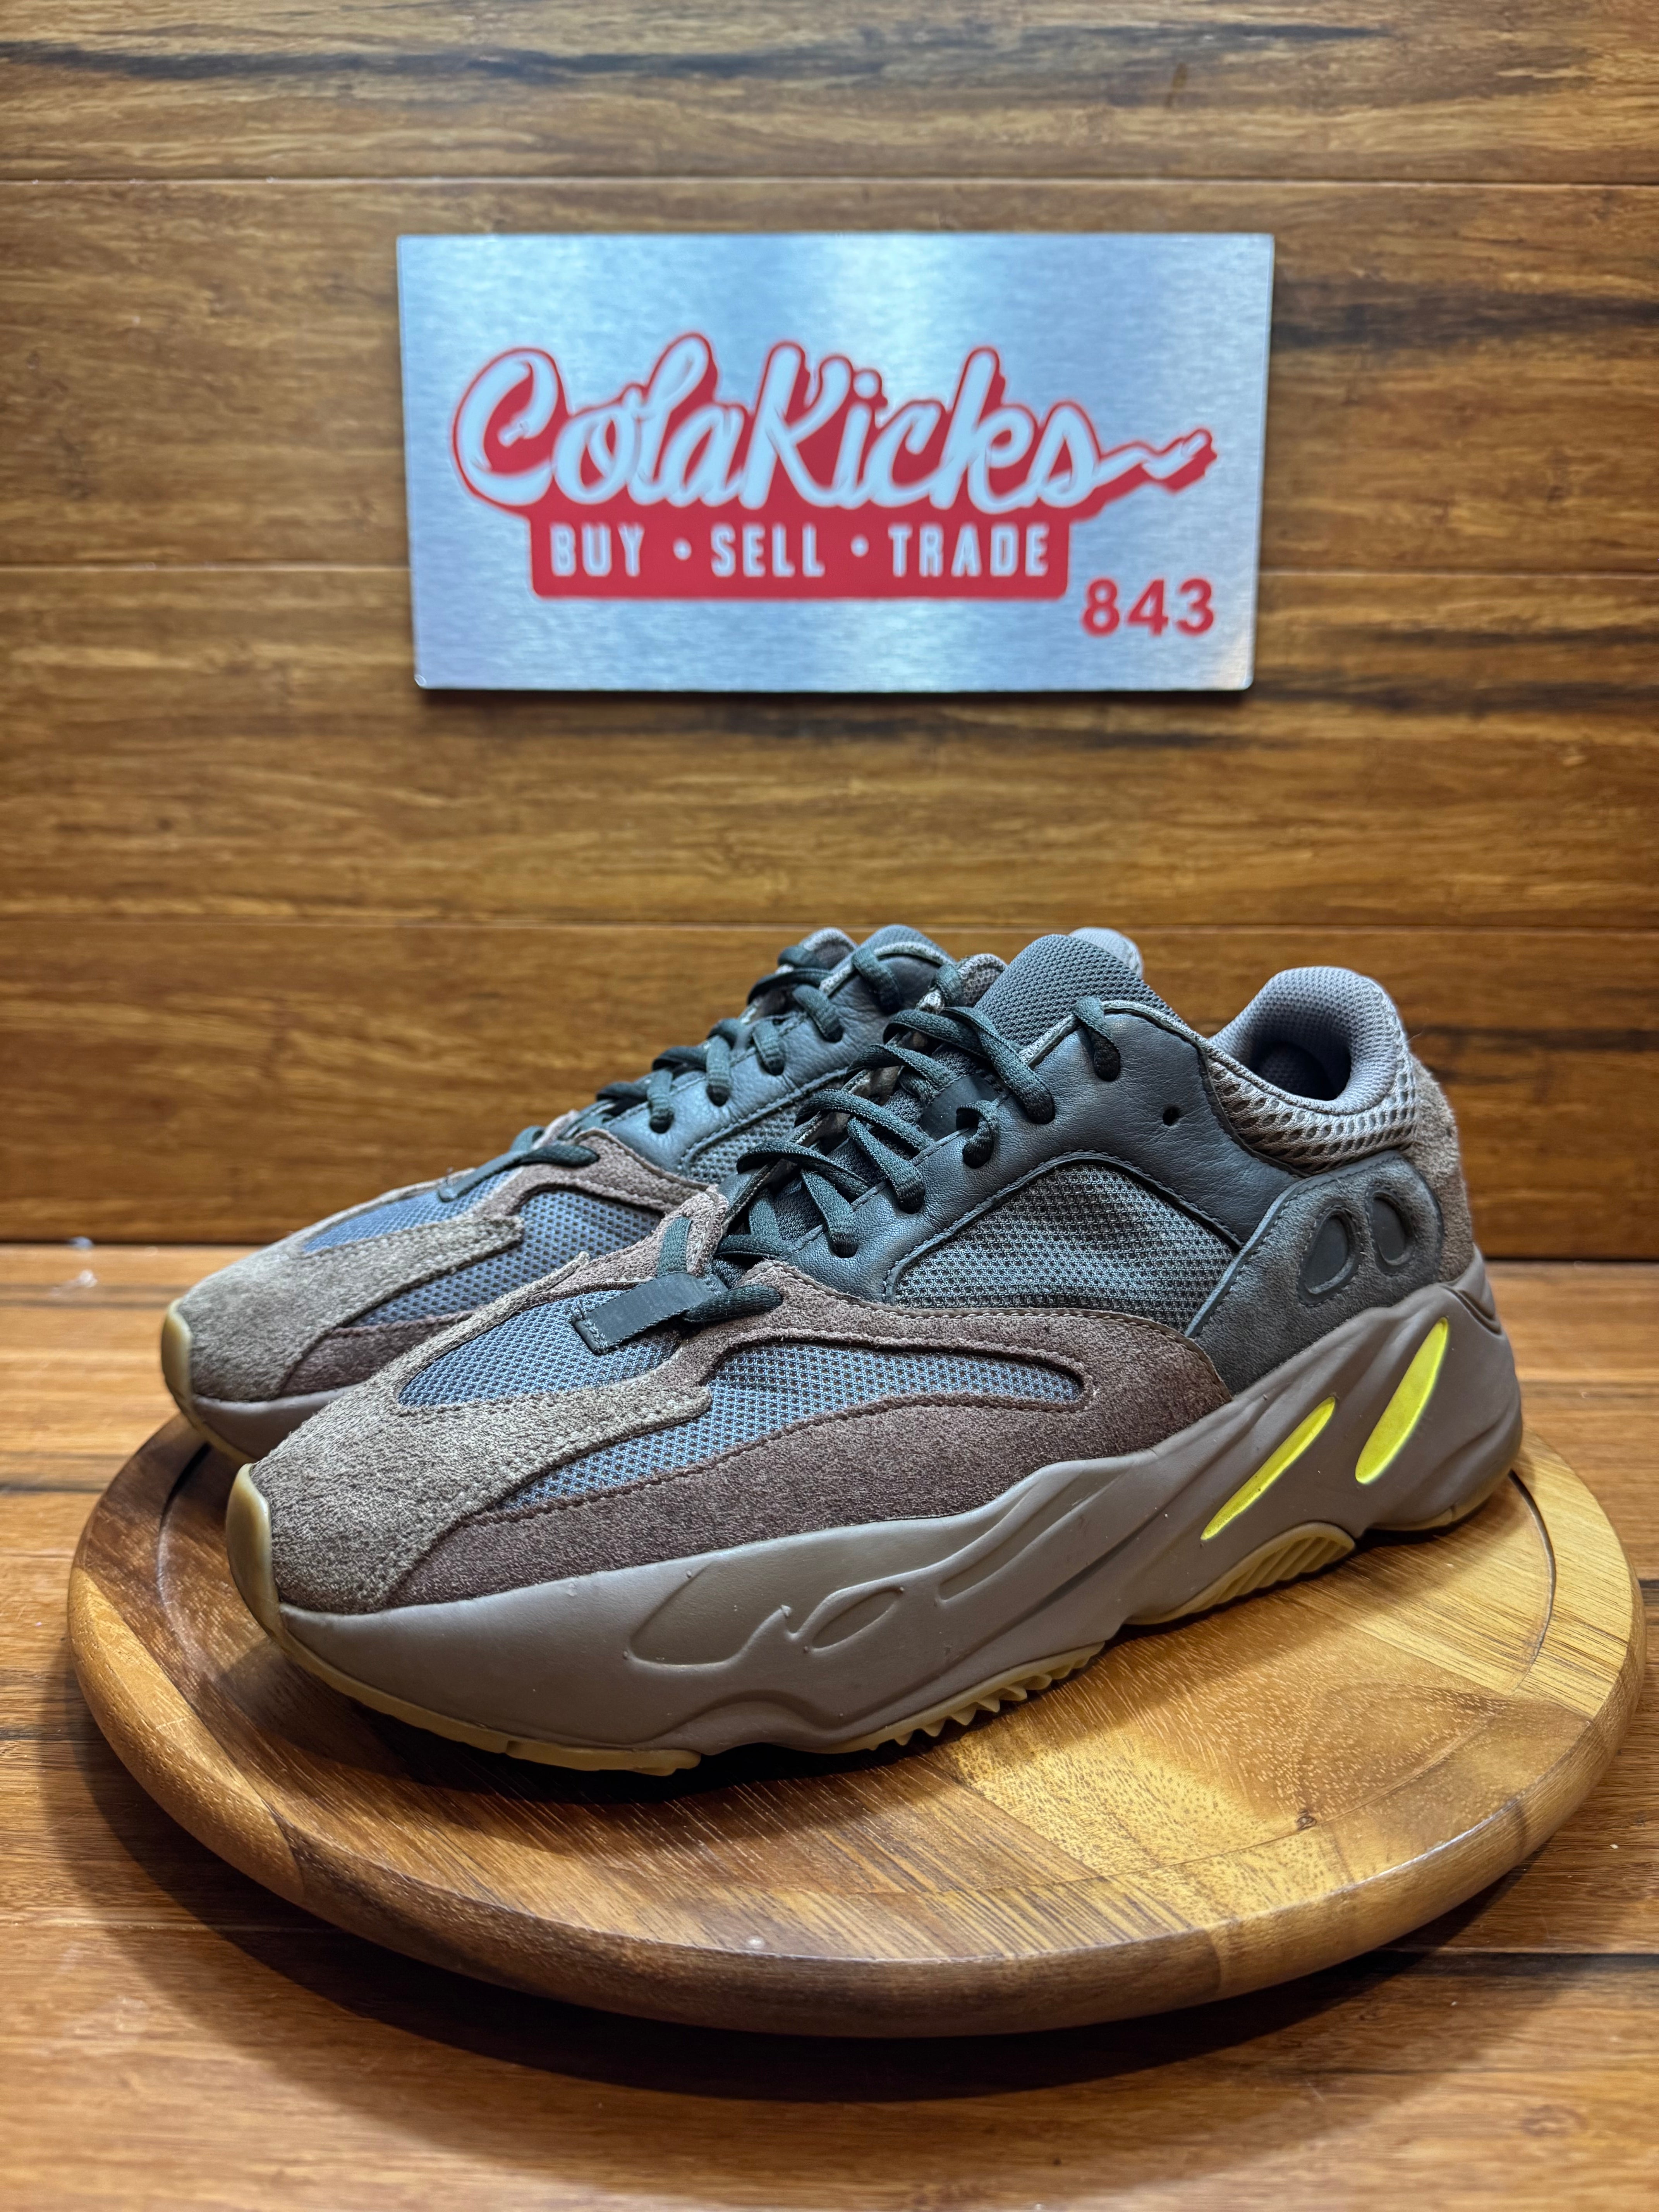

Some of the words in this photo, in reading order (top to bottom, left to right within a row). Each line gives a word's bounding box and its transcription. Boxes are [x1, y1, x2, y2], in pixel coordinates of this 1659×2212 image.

[455, 334, 1211, 510] ColaKicks
[549, 524, 643, 578] BUY
[709, 524, 825, 577] SELL
[888, 523, 1049, 577] TRADE
[1080, 578, 1215, 637] 843
